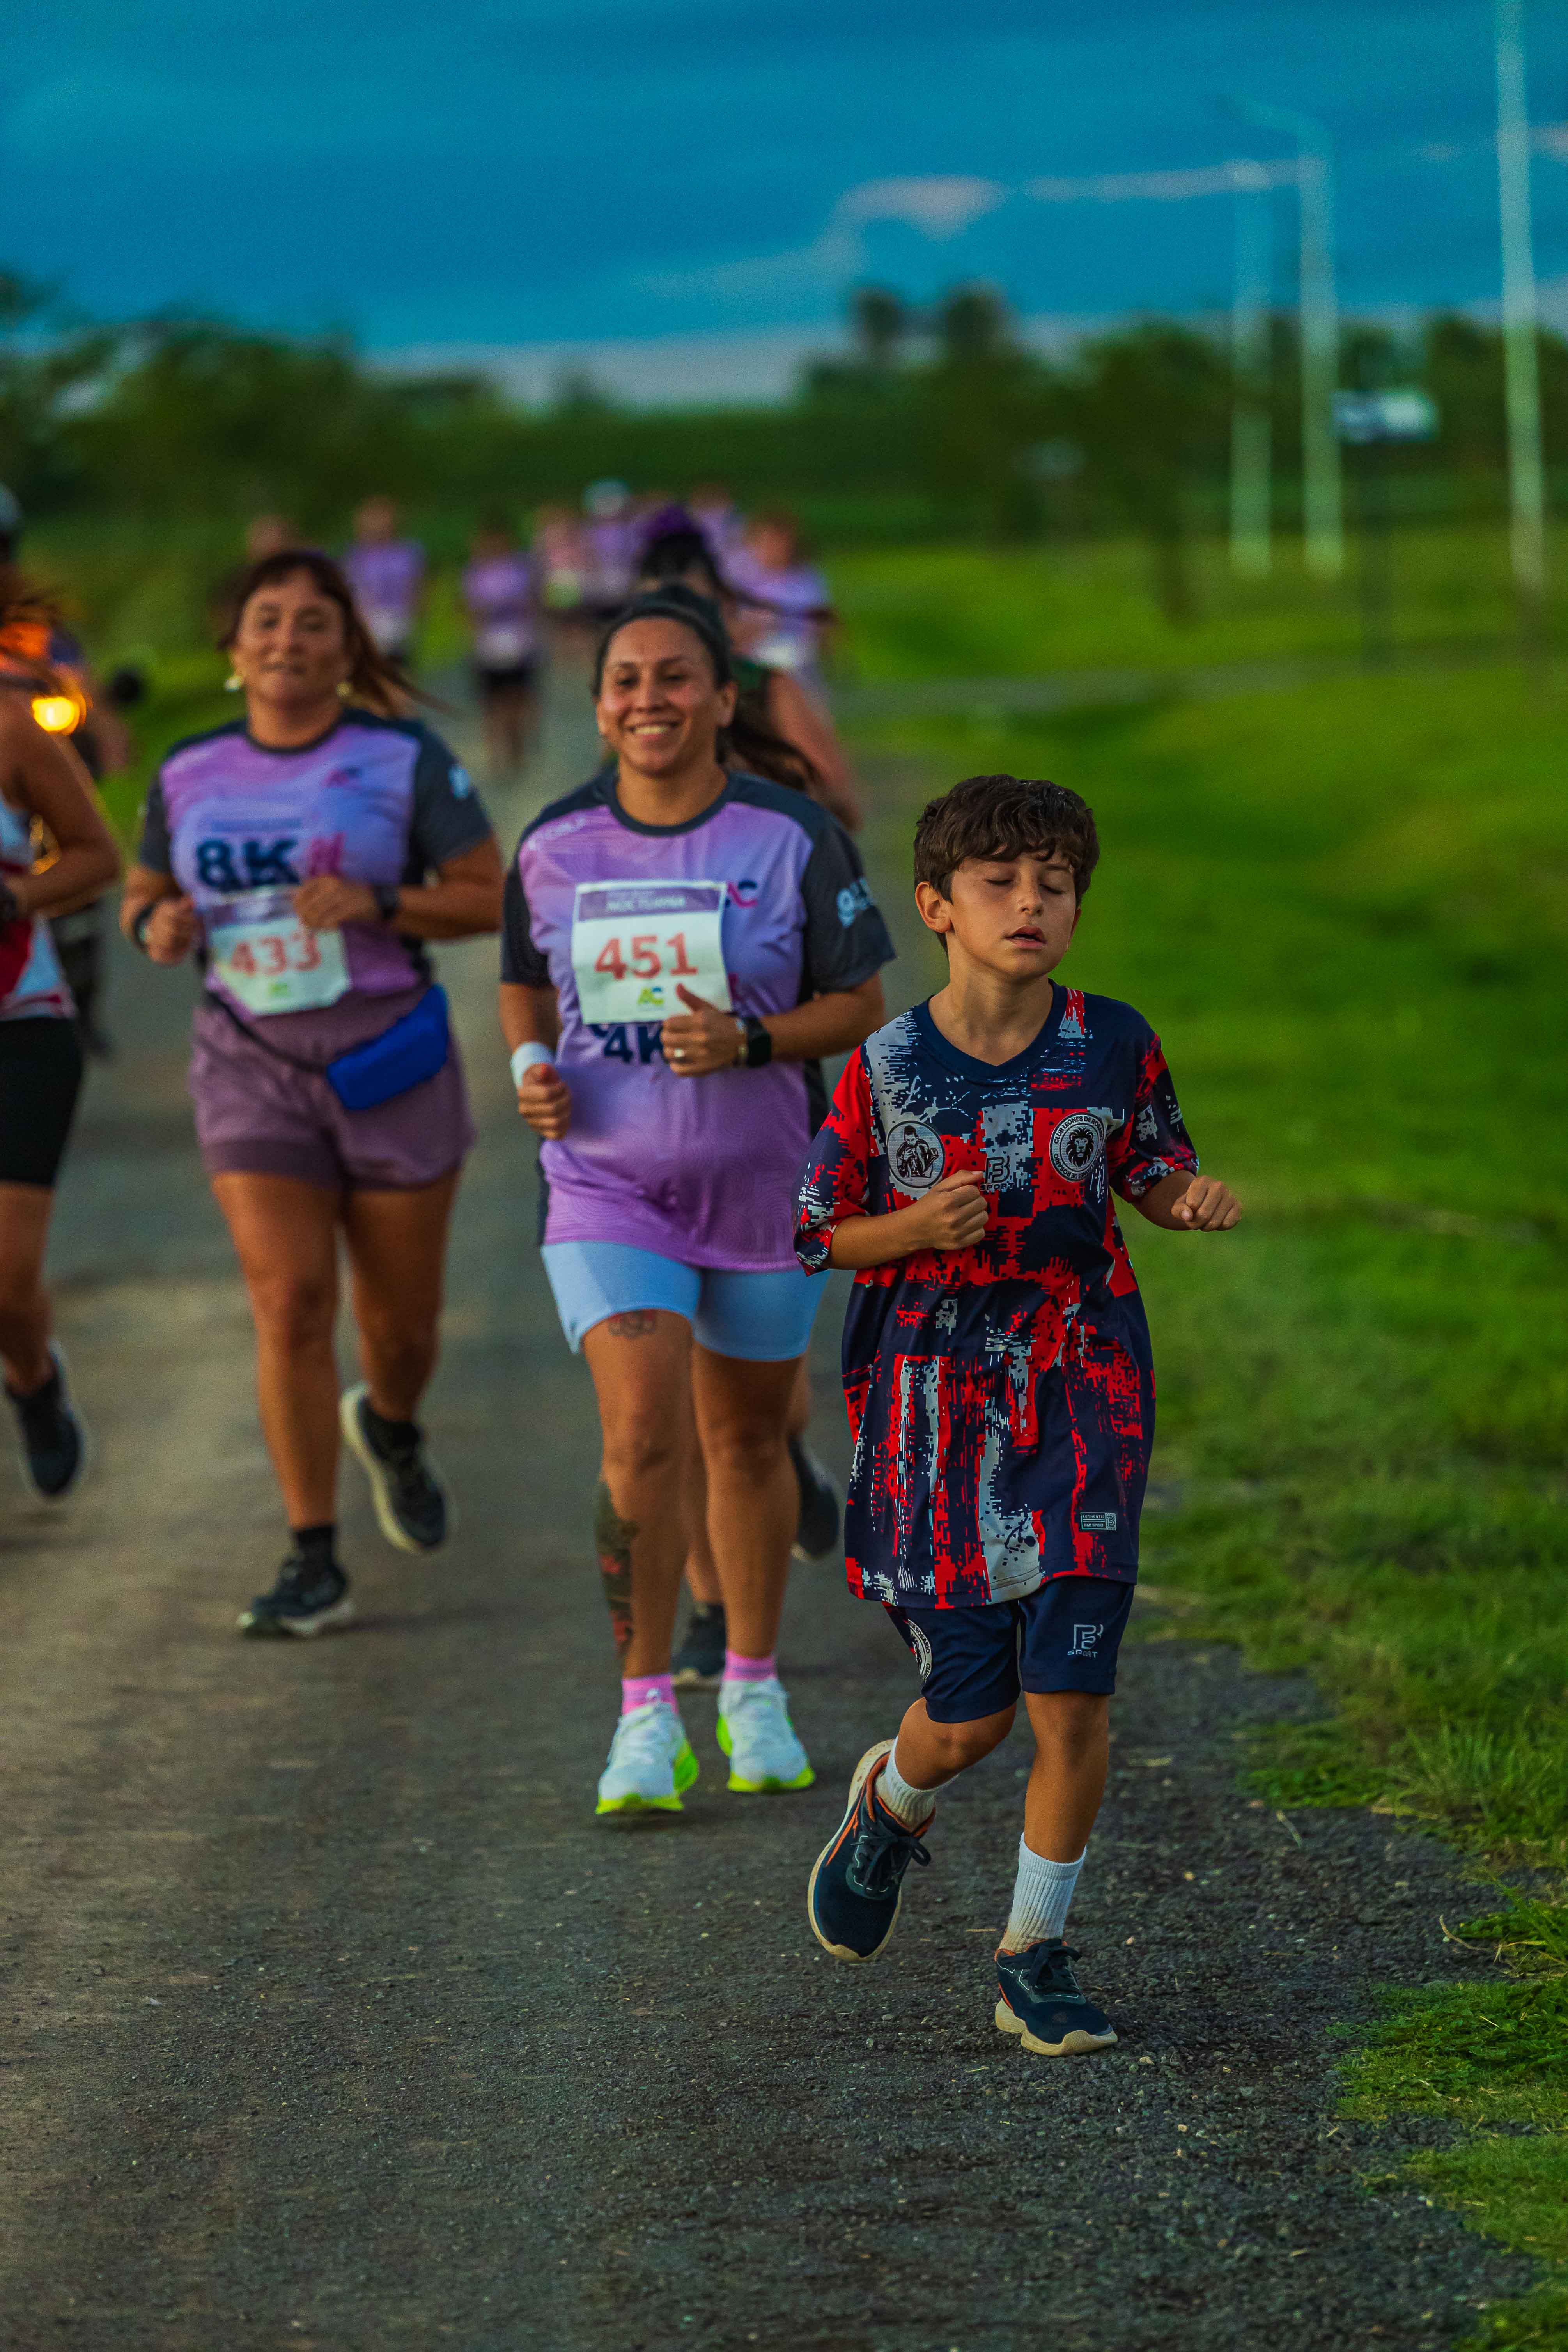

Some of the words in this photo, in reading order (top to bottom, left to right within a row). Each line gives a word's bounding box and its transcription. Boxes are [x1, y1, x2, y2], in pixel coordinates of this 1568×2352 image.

[197, 838, 301, 894] 8K
[231, 932, 321, 978] 433
[594, 931, 698, 980] 451
[1054, 1128, 1064, 1144] CLUB
[1063, 1116, 1083, 1130] LEONES
[1054, 1153, 1072, 1178] ROSARIO
[915, 1626, 930, 1654] ROSARIO
